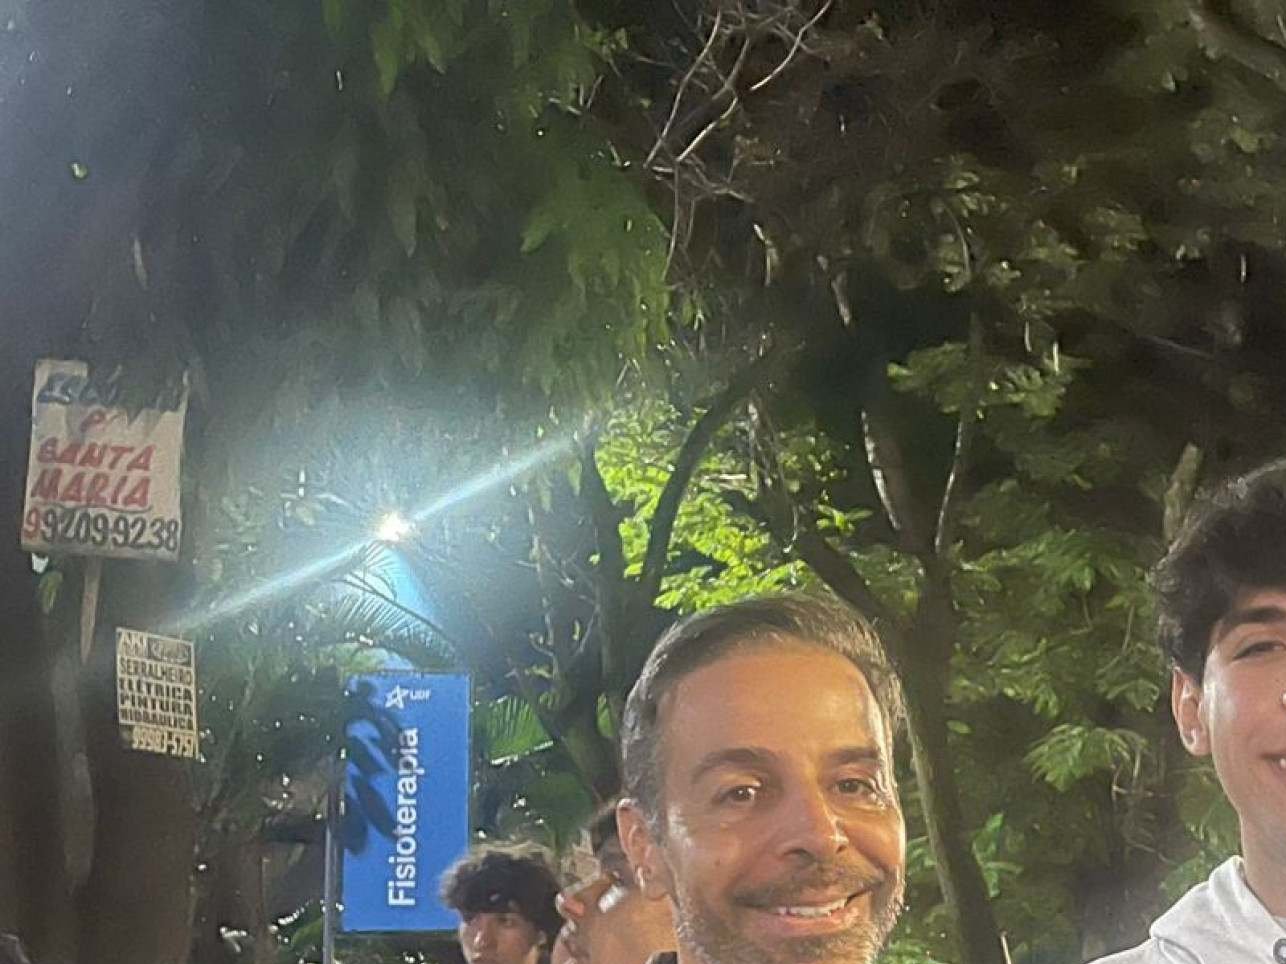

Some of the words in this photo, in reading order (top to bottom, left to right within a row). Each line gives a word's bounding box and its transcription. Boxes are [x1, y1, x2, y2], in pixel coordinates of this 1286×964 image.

[37, 437, 156, 471] SANTA
[31, 468, 151, 507] MARIA
[120, 692, 193, 717] PINTURA
[388, 727, 425, 906] Fisioterapia
